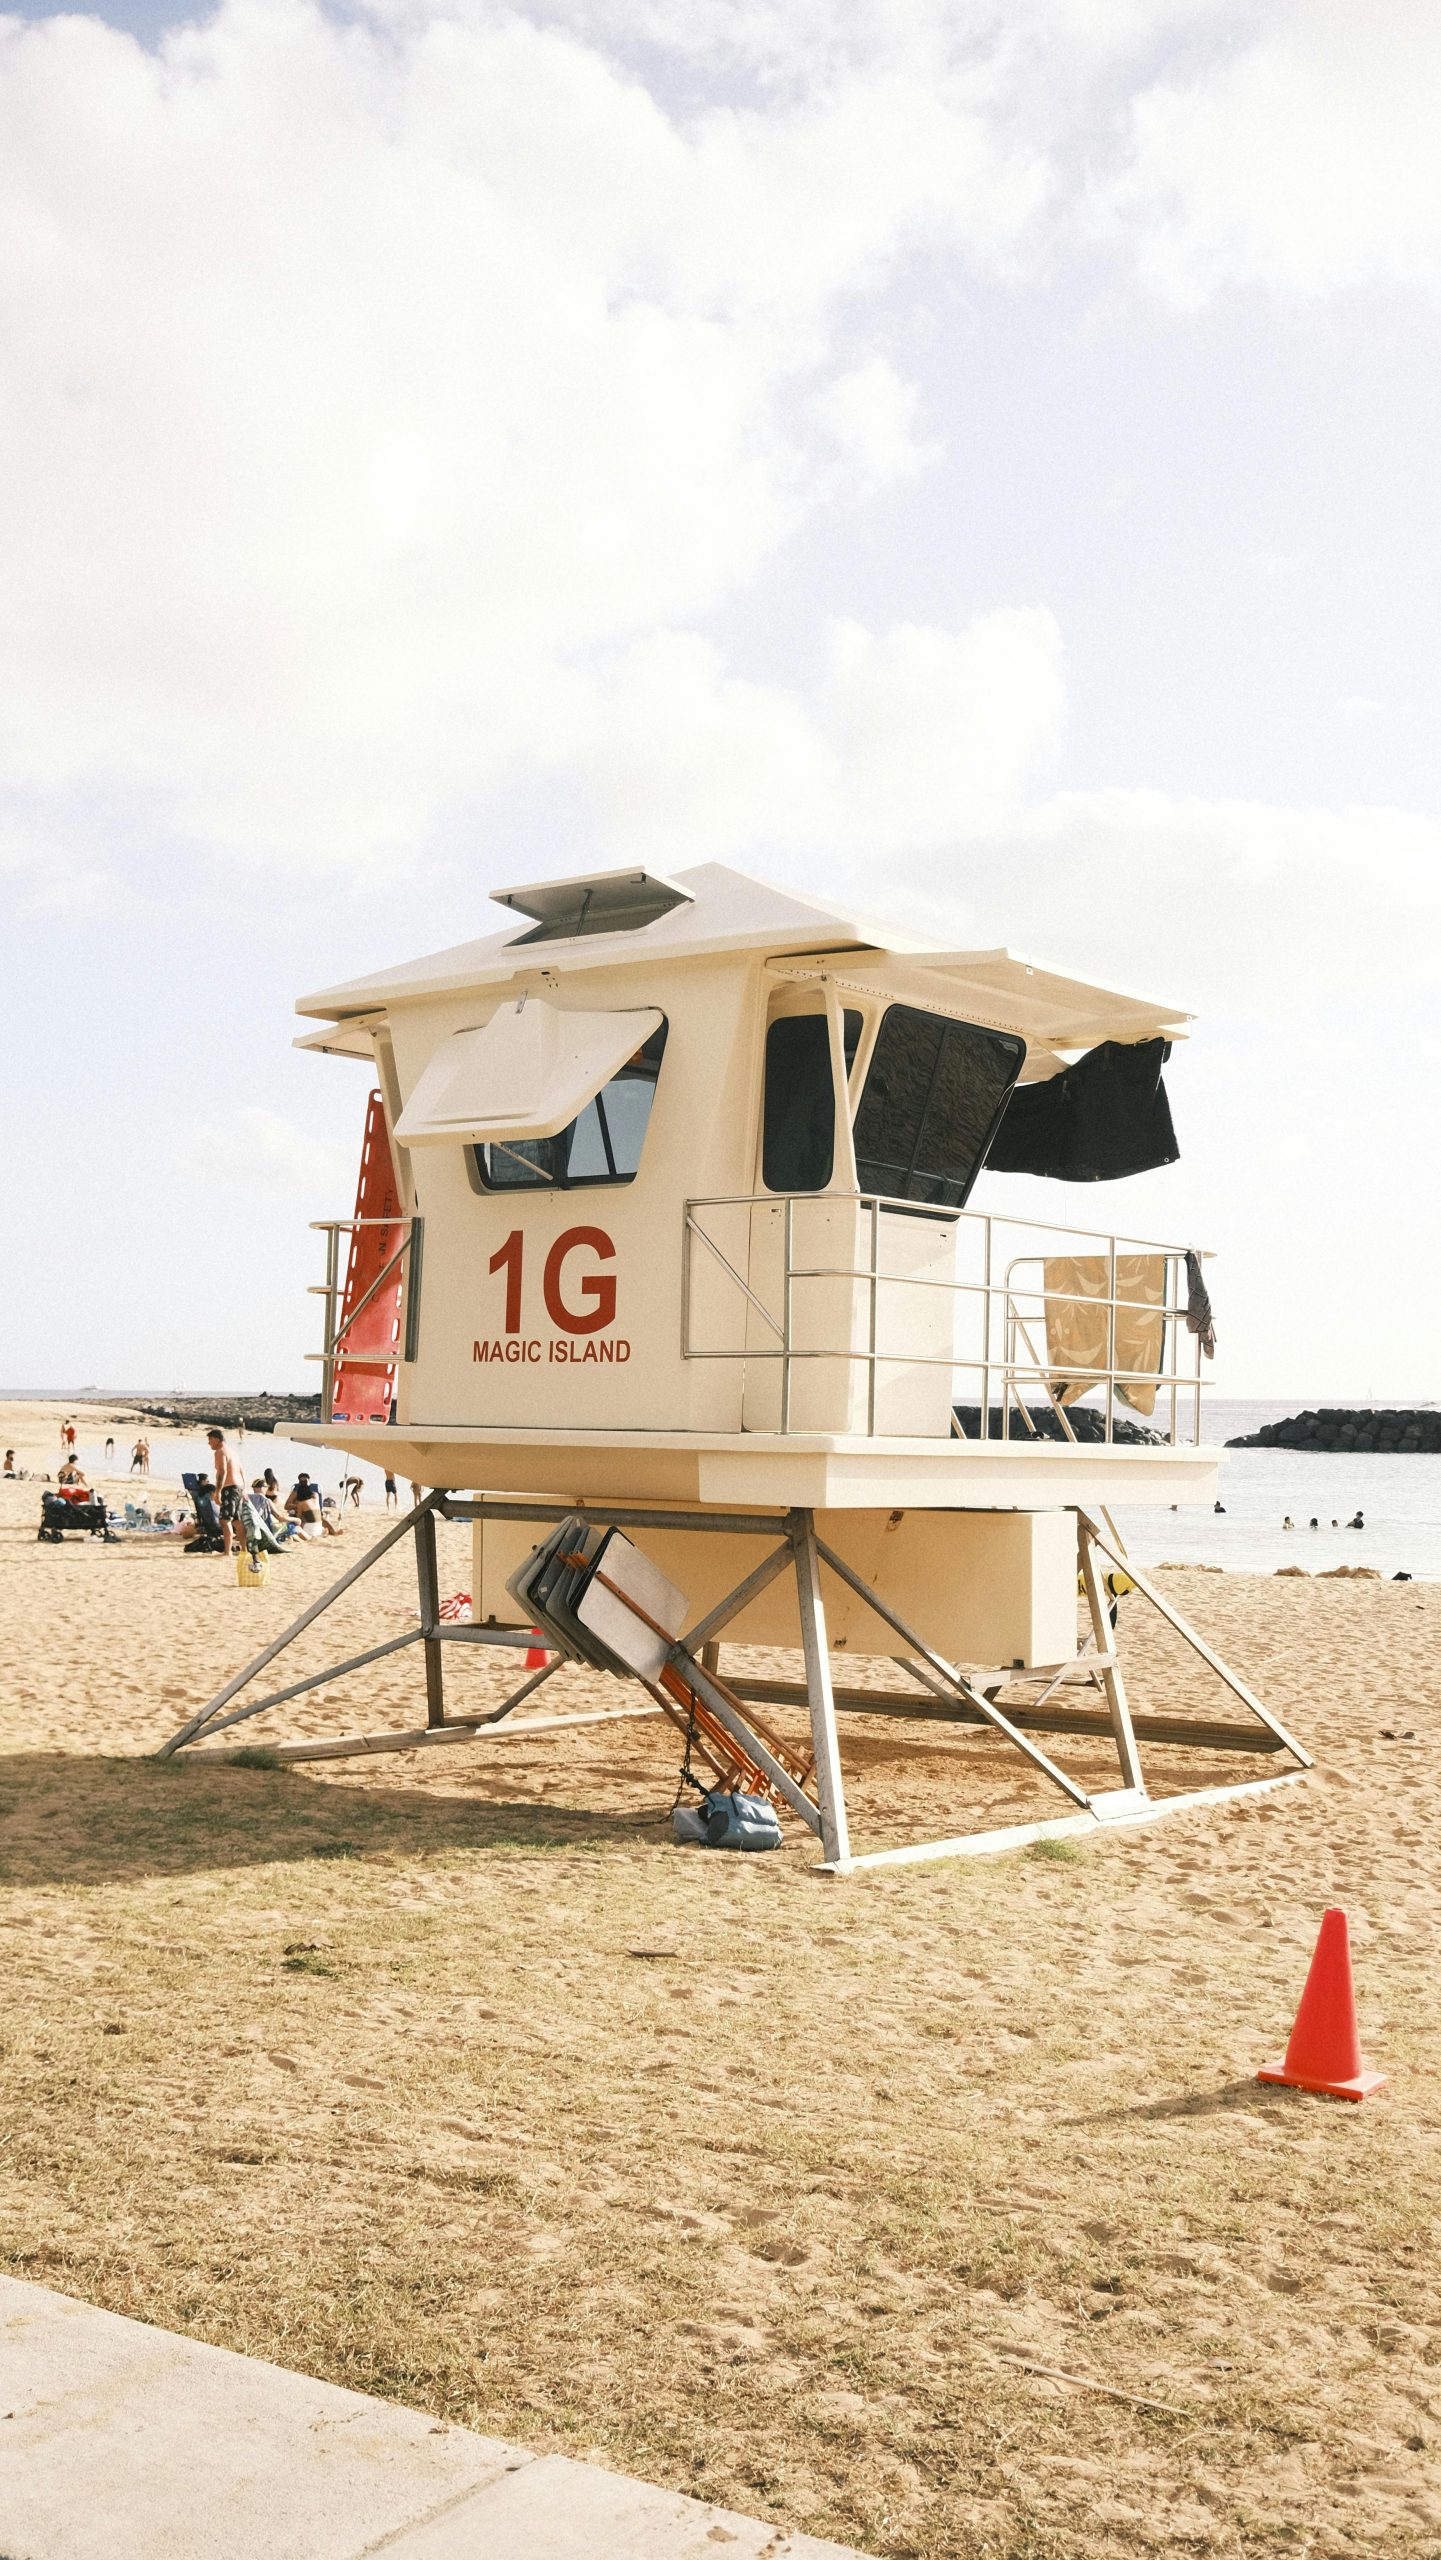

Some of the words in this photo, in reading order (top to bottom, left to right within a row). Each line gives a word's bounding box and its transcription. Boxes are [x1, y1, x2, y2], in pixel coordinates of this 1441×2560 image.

[489, 1226, 617, 1334] 1G
[473, 1340, 542, 1362] MAGIC
[549, 1340, 631, 1362] ISLAND
